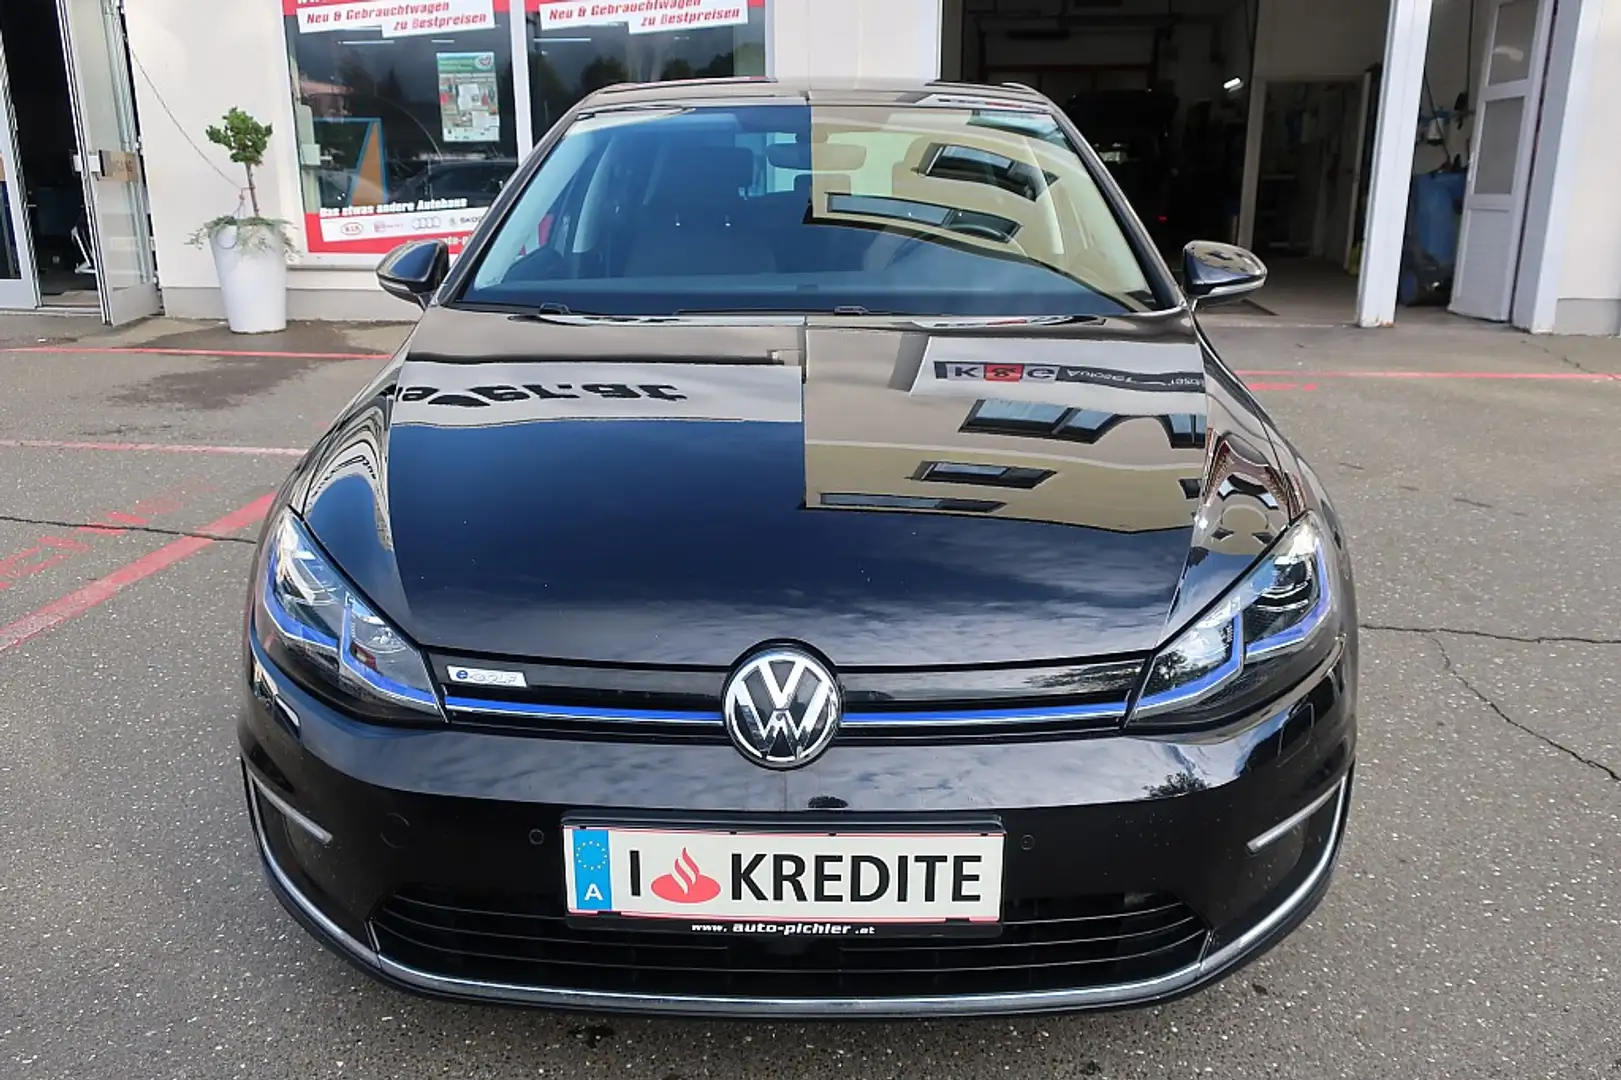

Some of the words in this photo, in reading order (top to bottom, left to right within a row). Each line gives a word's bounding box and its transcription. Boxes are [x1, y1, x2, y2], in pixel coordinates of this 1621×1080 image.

[306, 12, 329, 24] Neu
[346, 2, 450, 21] Gebrauchtwagen
[549, 8, 573, 20] Neu
[591, 0, 701, 16] Gebrauchtwagen
[641, 15, 656, 26] zu
[660, 7, 740, 25] Bestpreisen
[393, 20, 408, 31] zu
[412, 13, 487, 29] Bestpreisen
[377, 201, 415, 214] andere
[416, 198, 468, 211] Autohaus
[629, 850, 641, 897] I
[731, 852, 983, 903] KREDITE
[583, 883, 603, 901] A
